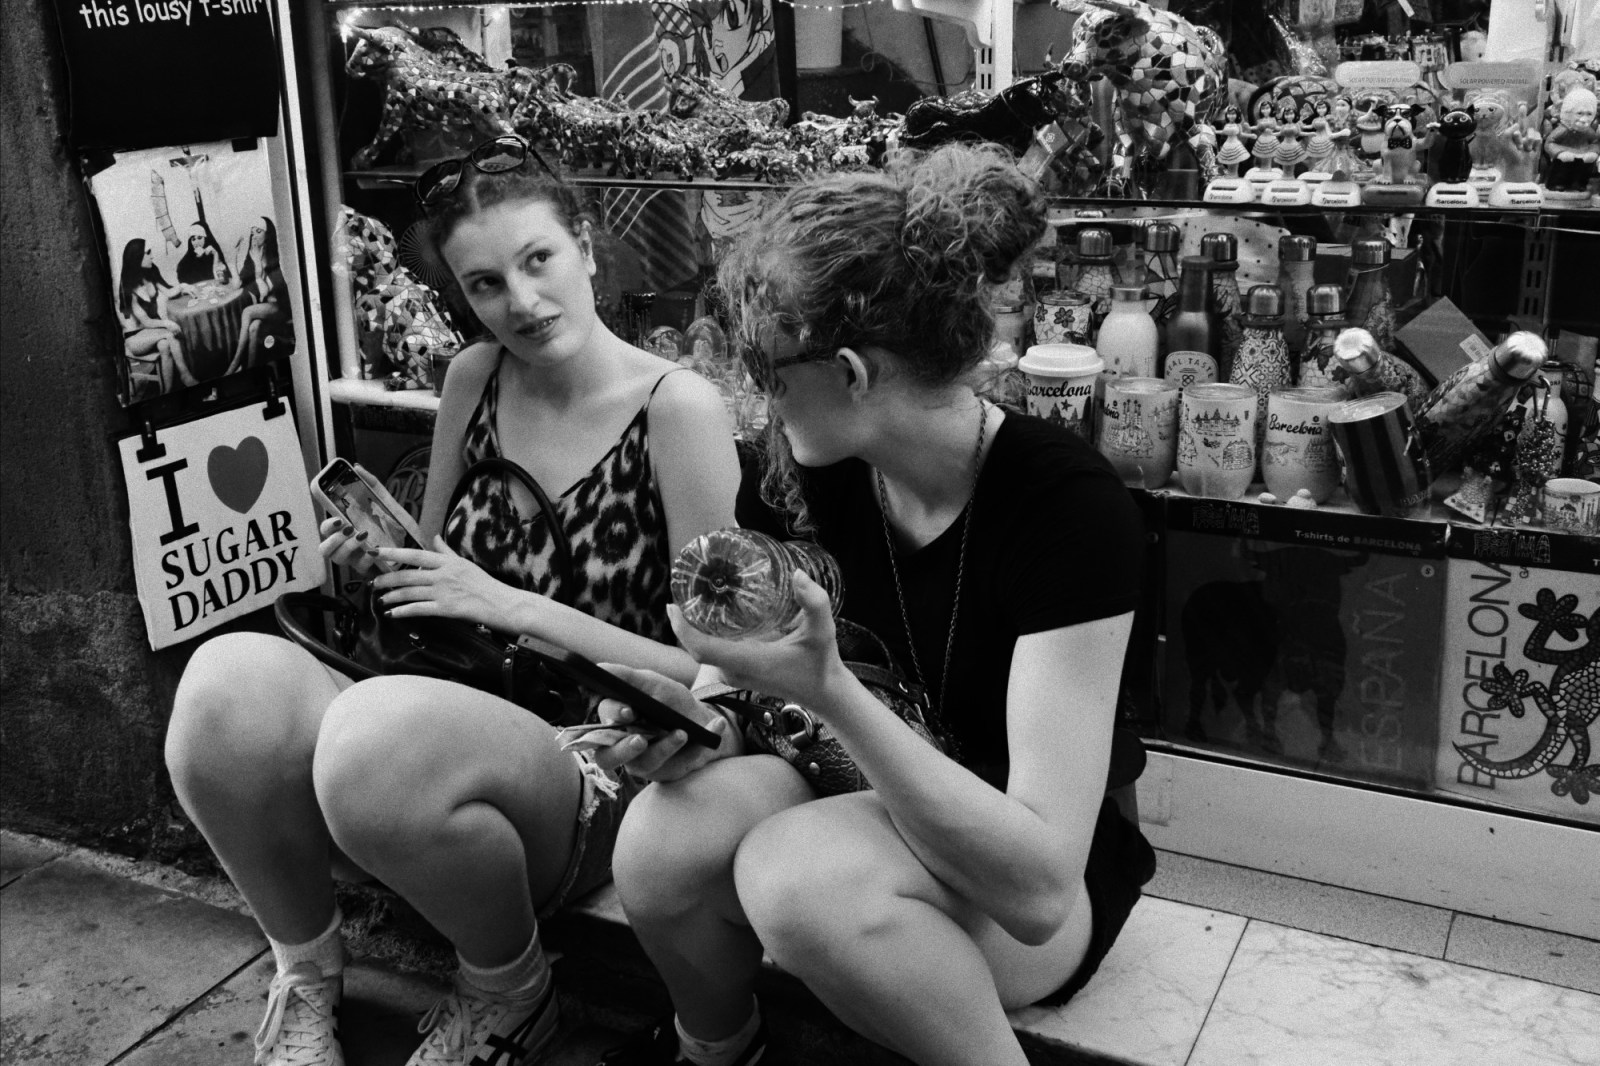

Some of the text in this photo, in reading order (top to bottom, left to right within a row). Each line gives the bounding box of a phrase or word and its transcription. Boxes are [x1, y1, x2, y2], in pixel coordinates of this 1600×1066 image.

[79, 0, 130, 29] this
[135, 0, 192, 26] lousy
[1269, 413, 1323, 436] Barcelona
[145, 458, 200, 546] I
[1295, 530, 1335, 542] T-shirts
[1337, 535, 1351, 543] de
[1353, 536, 1422, 551] BARCELONA
[161, 510, 298, 590] SUGAR
[168, 546, 299, 632] DADDY
[1352, 572, 1408, 771] ESPAÑA
